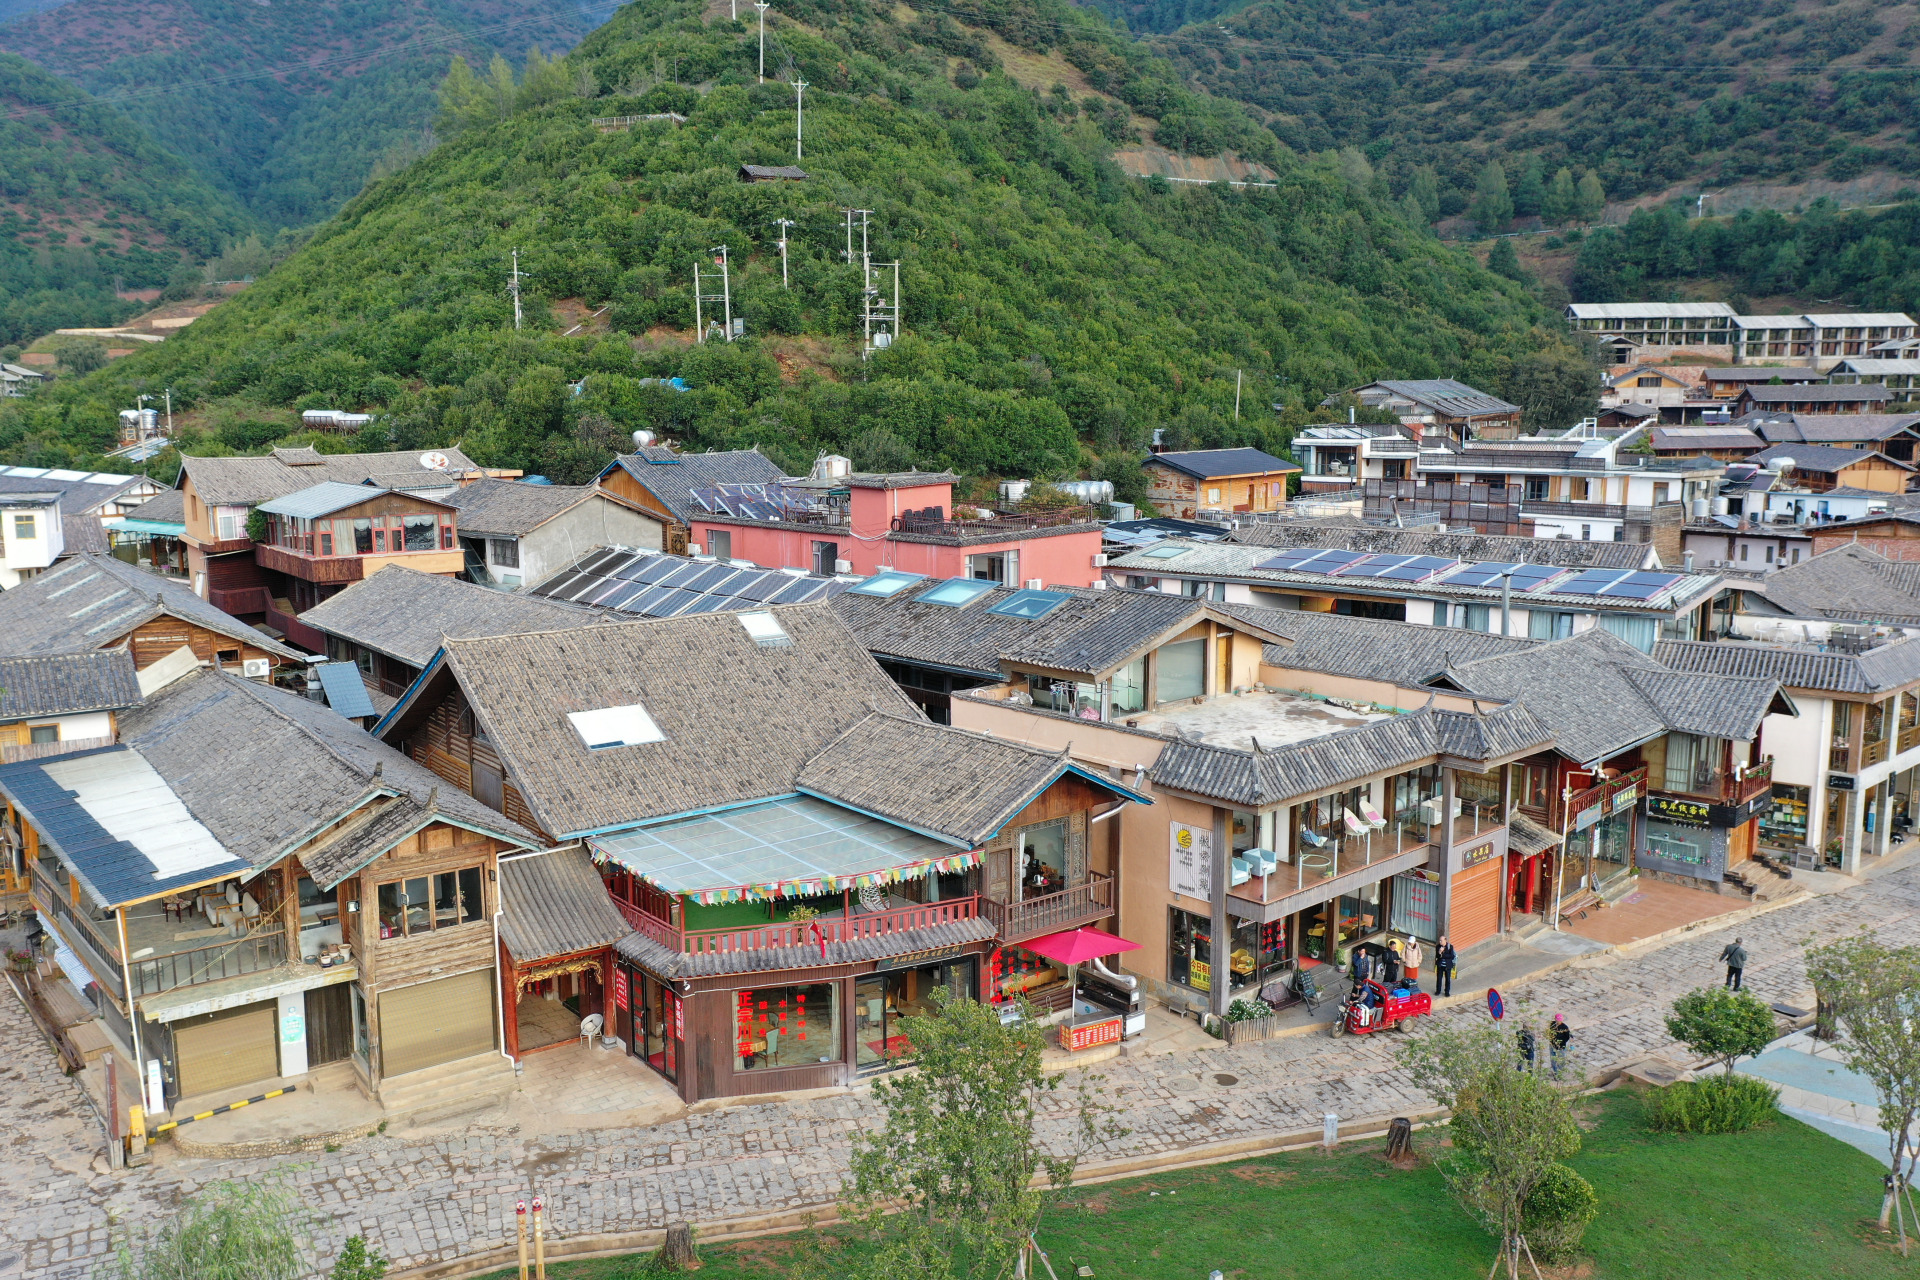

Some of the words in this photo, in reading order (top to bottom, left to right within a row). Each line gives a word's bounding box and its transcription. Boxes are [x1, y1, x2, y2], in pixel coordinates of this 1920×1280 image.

[1659, 800, 1708, 817] 海岸线客栈
[1472, 844, 1489, 859] 水果店
[736, 991, 754, 1058] 正宗川菜
